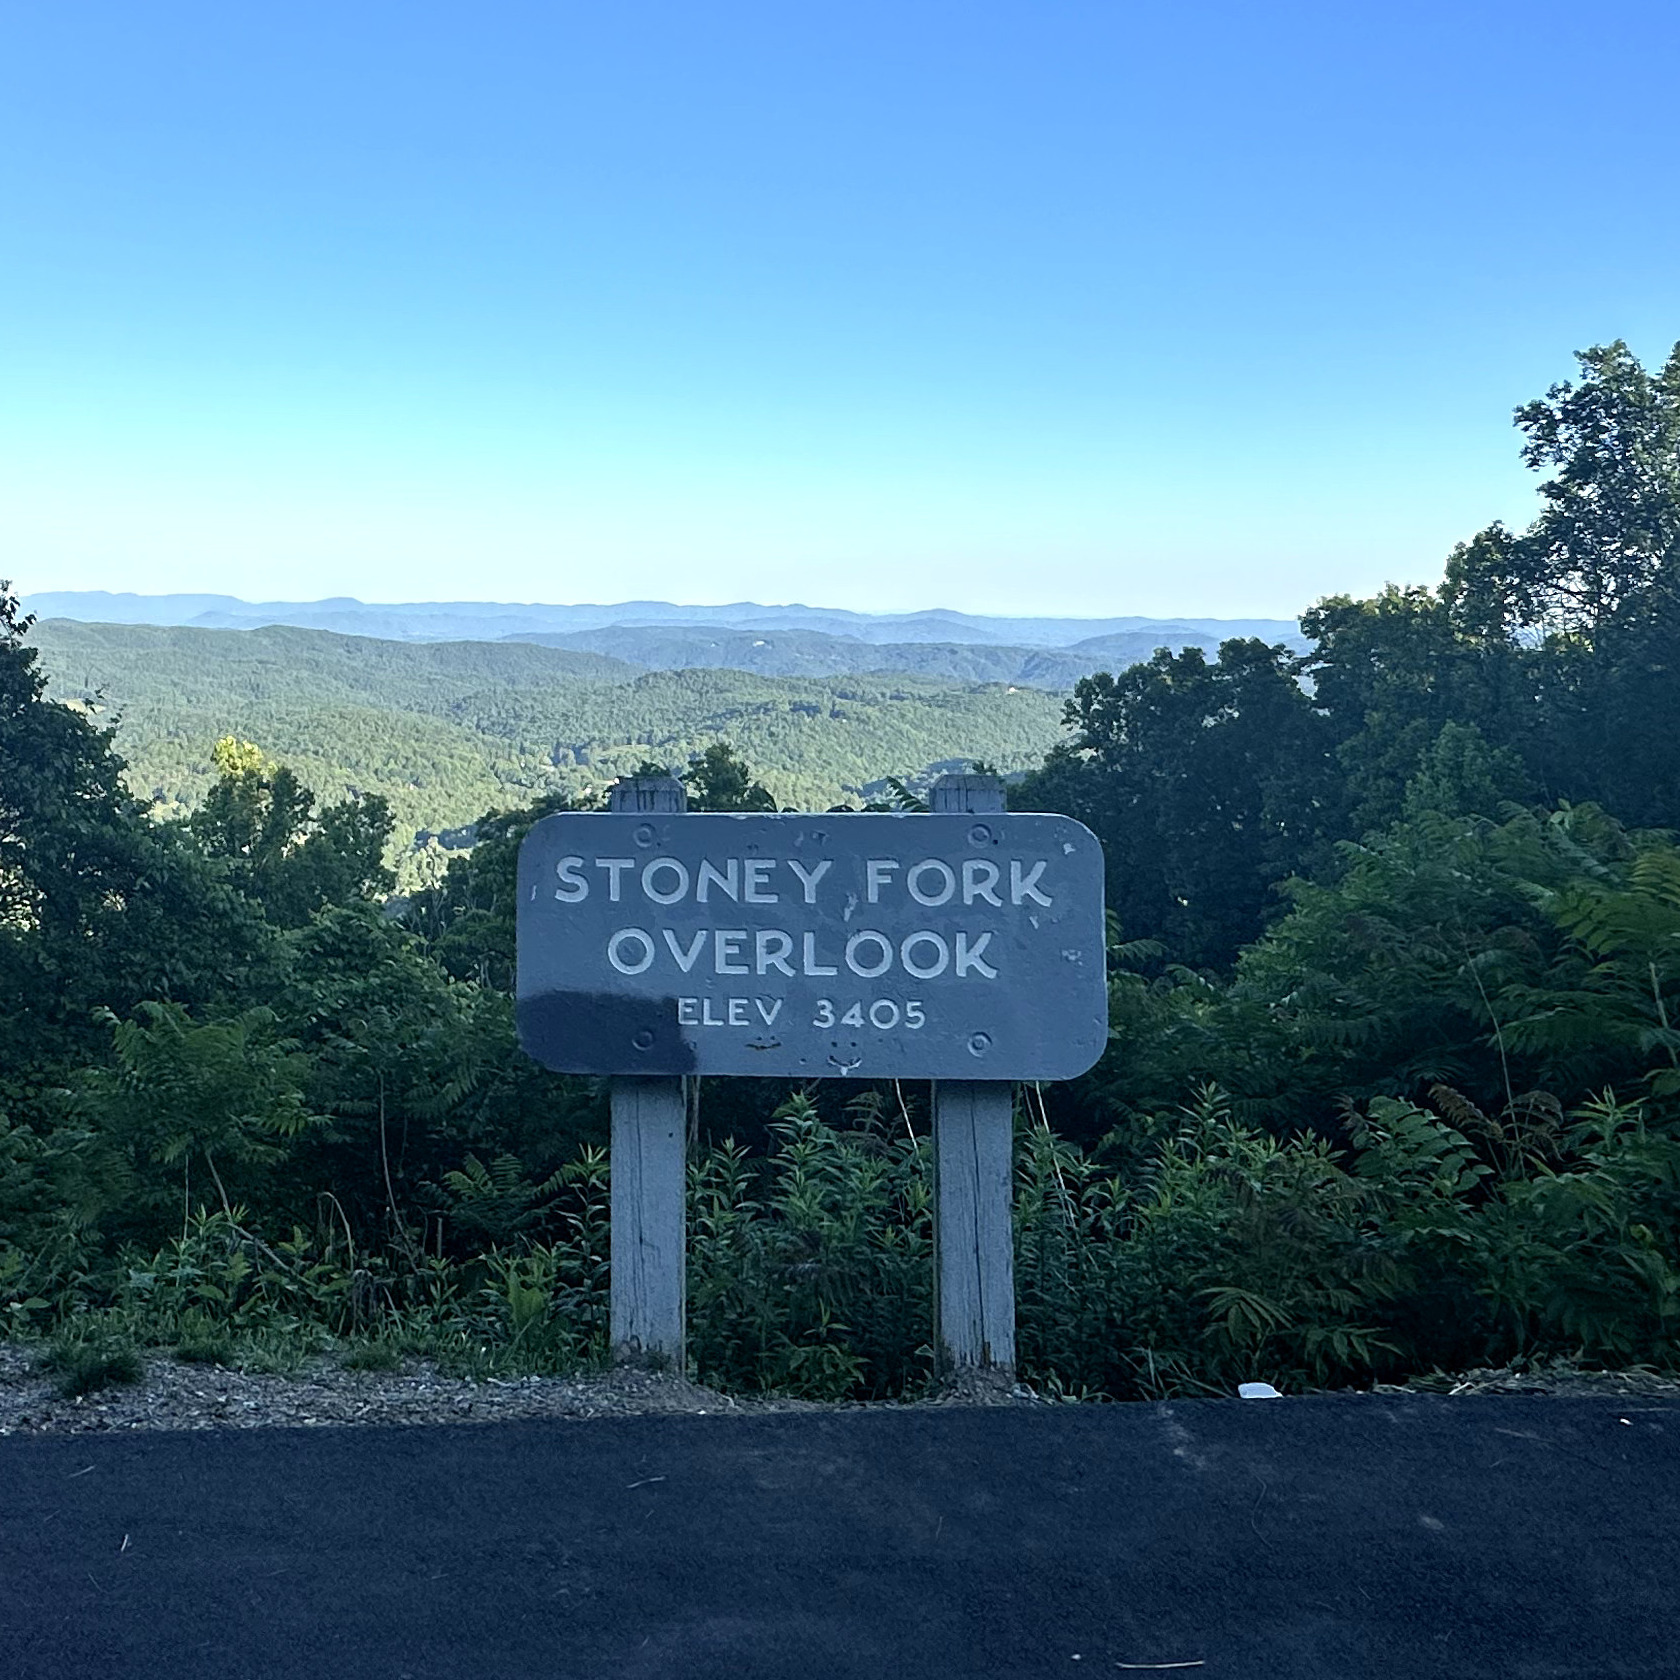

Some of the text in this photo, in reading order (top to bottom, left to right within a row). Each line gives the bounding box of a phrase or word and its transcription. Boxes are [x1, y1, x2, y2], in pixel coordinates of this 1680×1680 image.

[555, 855, 1052, 908] STONEY FORK
[607, 927, 998, 980] OVERLOOK
[677, 997, 926, 1030] ELEV 3405
